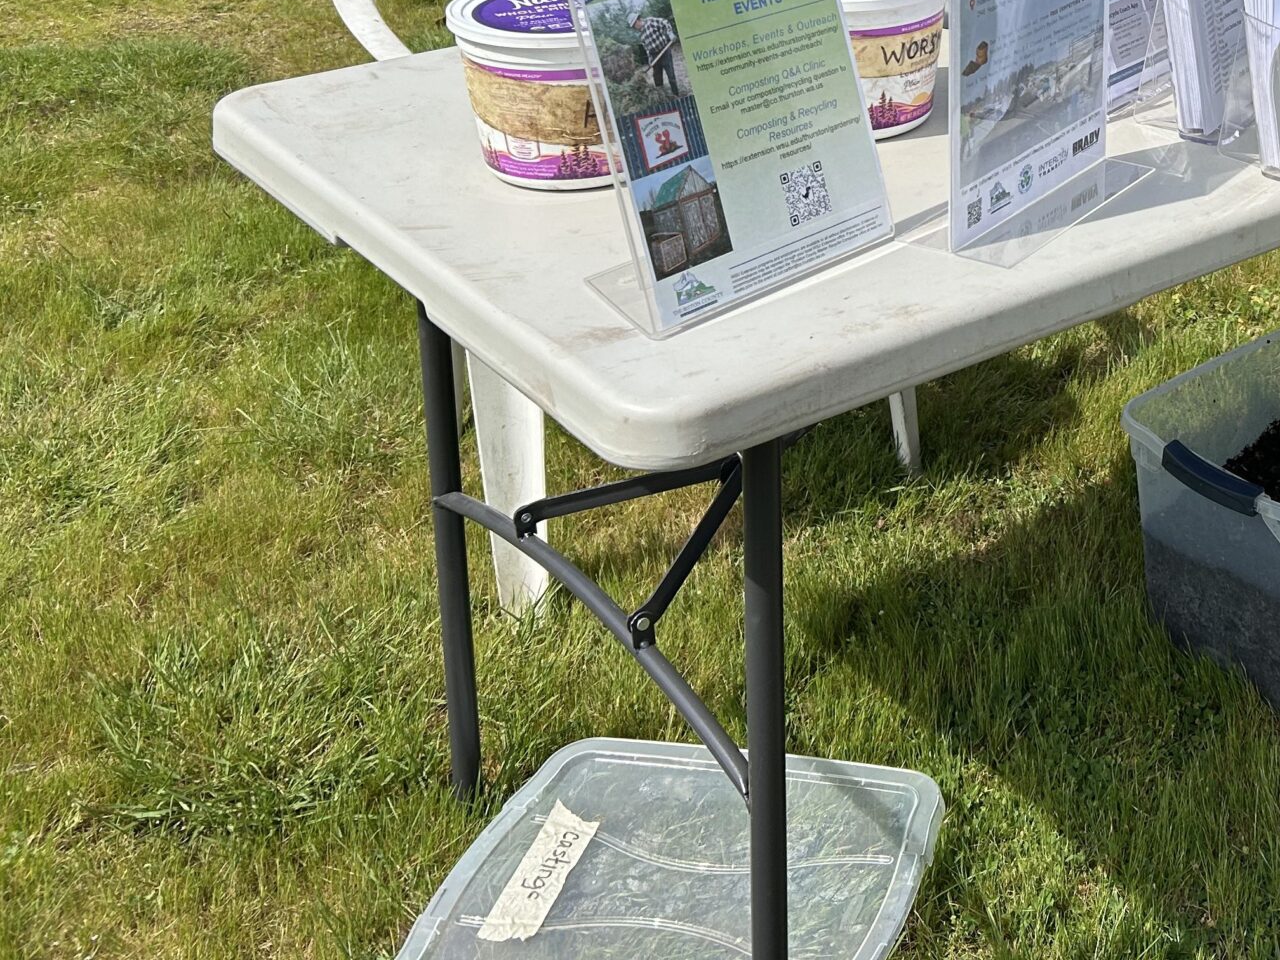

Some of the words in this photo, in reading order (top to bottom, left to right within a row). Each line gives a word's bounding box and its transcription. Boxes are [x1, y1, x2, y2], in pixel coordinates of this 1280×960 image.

[692, 40, 750, 62] Workshops,
[752, 29, 785, 45] Events
[788, 24, 794, 34] &
[796, 13, 837, 31] Outreach
[710, 102, 730, 114] Email
[731, 96, 745, 109] your
[747, 77, 813, 103] composting/recycling
[813, 68, 839, 81] question
[728, 74, 780, 96] Composting
[781, 65, 801, 80] Q&A
[803, 59, 826, 72] Clinic
[736, 116, 788, 139] Composting
[790, 112, 797, 121] &
[798, 99, 838, 118] Recycling
[769, 121, 813, 142] Resources
[780, 143, 812, 160] resources/
[1072, 127, 1100, 156] BRADY
